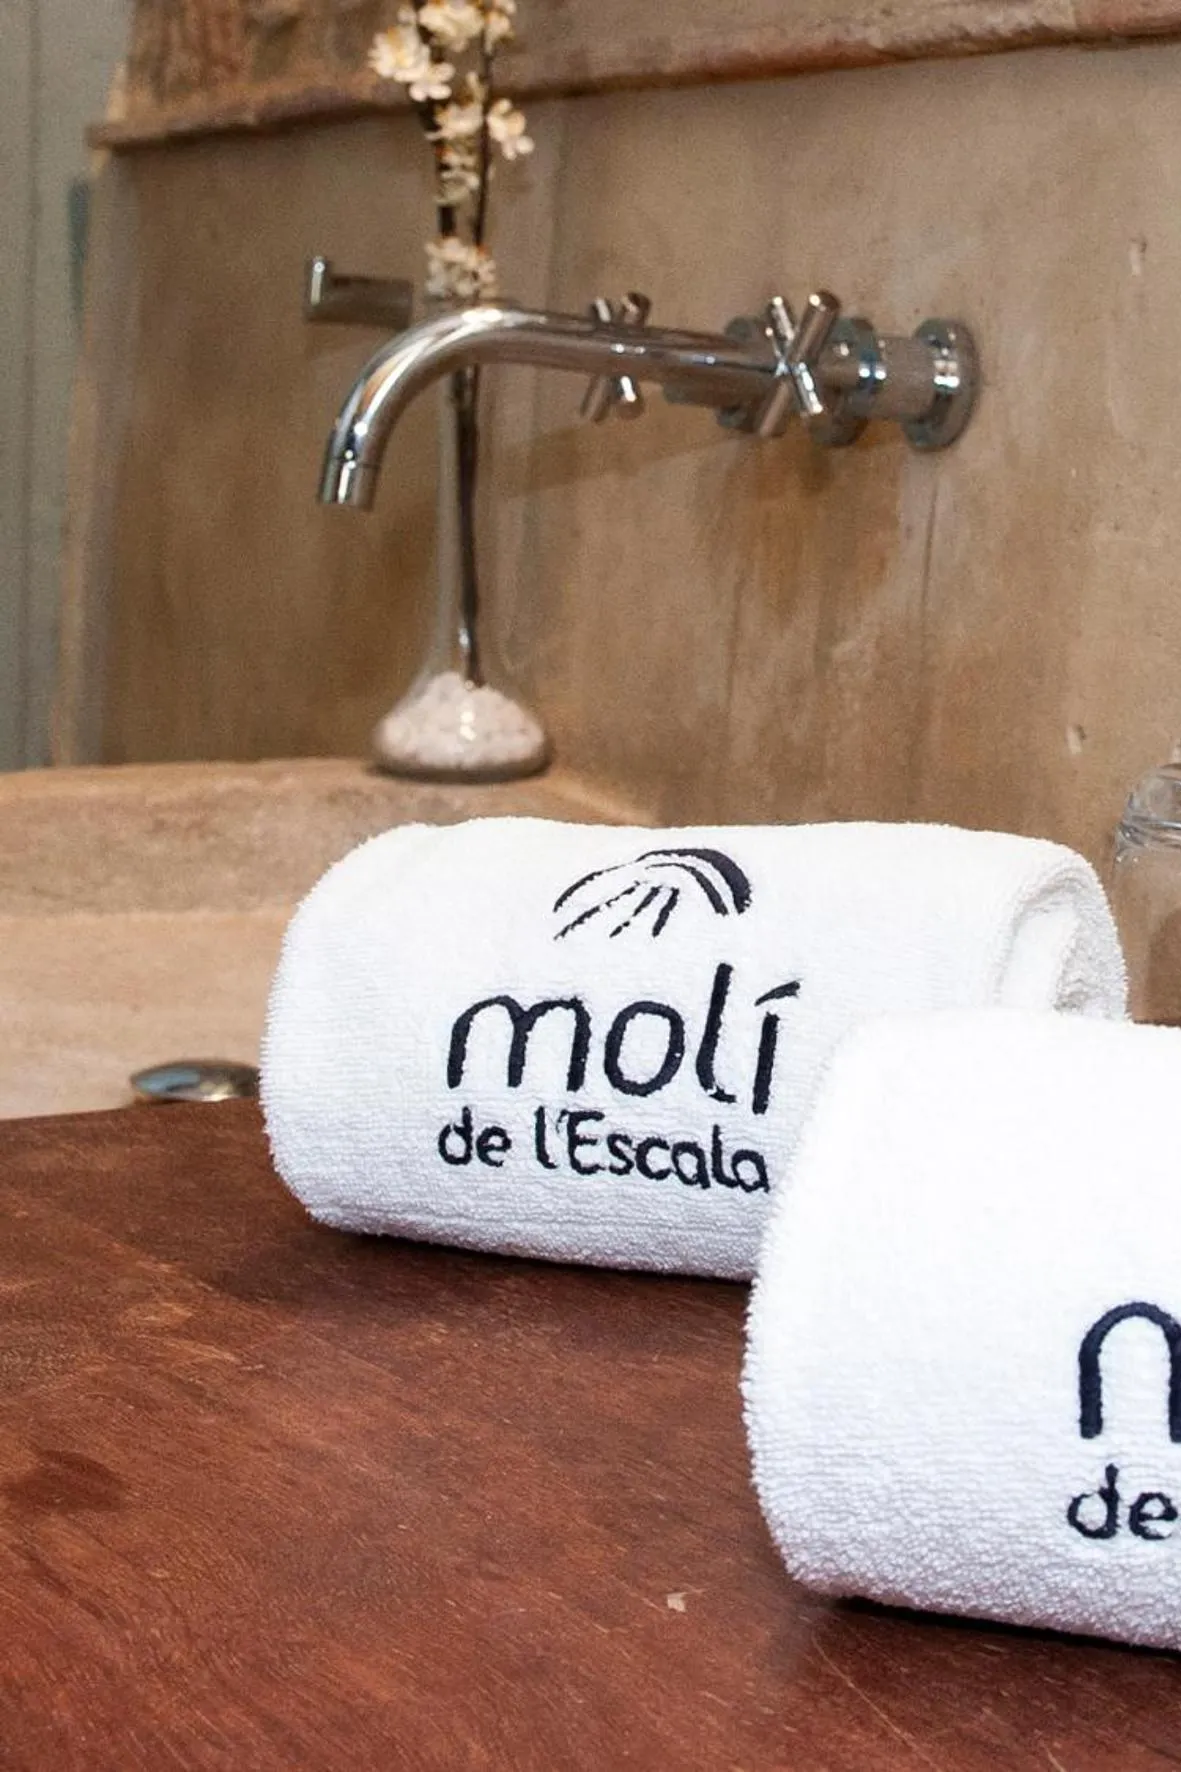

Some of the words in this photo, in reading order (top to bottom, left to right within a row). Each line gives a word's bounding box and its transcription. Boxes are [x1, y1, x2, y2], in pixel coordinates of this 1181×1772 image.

[446, 962, 801, 1115] molí
[437, 1106, 512, 1168] de
[534, 1105, 771, 1194] l'Escala
[1066, 1463, 1179, 1541] de
